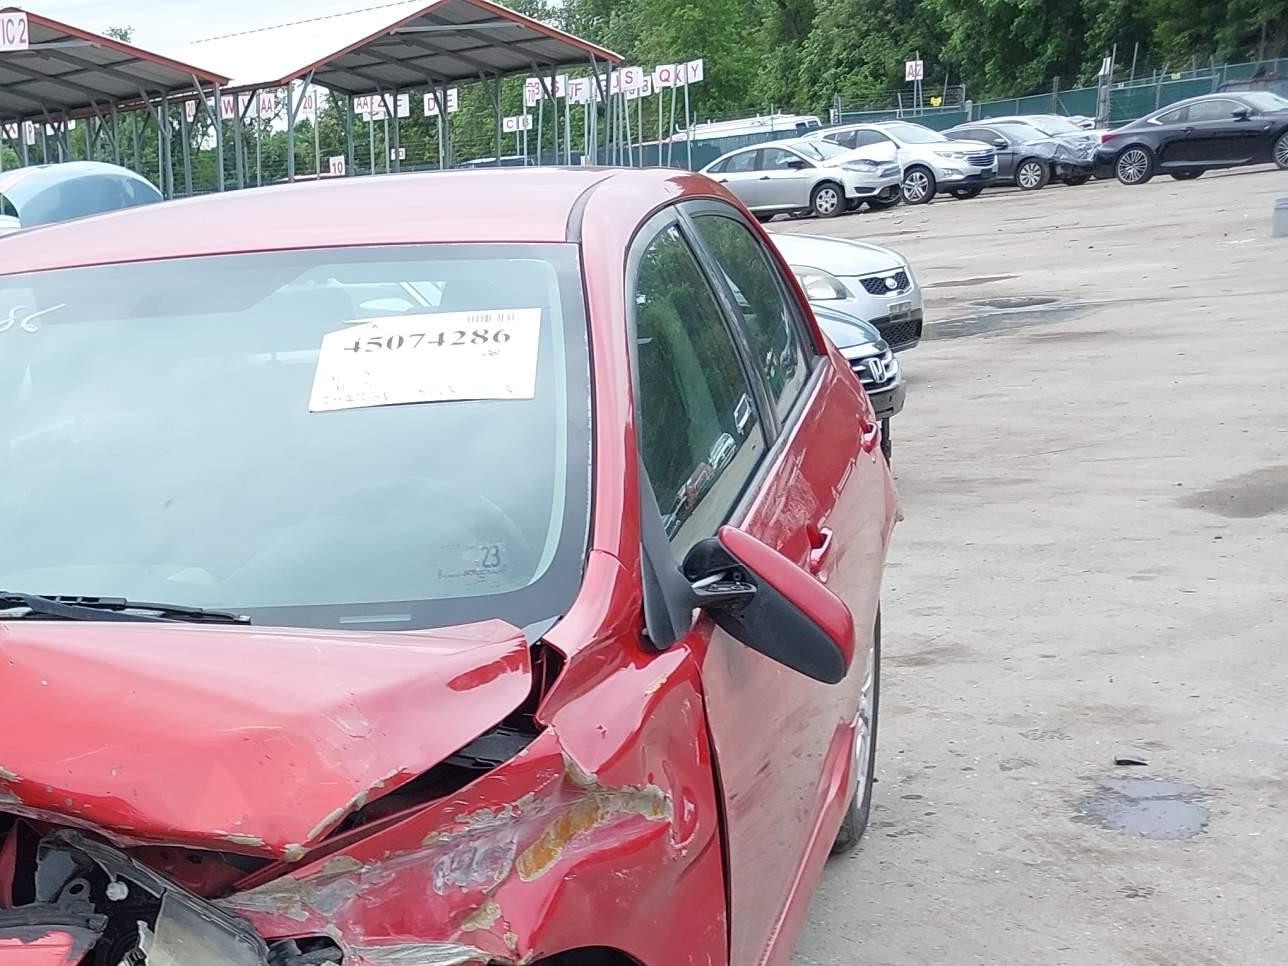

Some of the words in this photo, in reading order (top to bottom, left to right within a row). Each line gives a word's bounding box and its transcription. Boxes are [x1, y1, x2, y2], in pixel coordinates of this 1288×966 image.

[18, 18, 27, 44] 2
[625, 70, 634, 84] S
[659, 69, 671, 83] Q
[691, 63, 699, 78] Y
[261, 100, 273, 113] AA
[356, 98, 369, 110] AA
[506, 120, 514, 129] C
[332, 161, 343, 174] 10
[343, 328, 511, 353] 45074286
